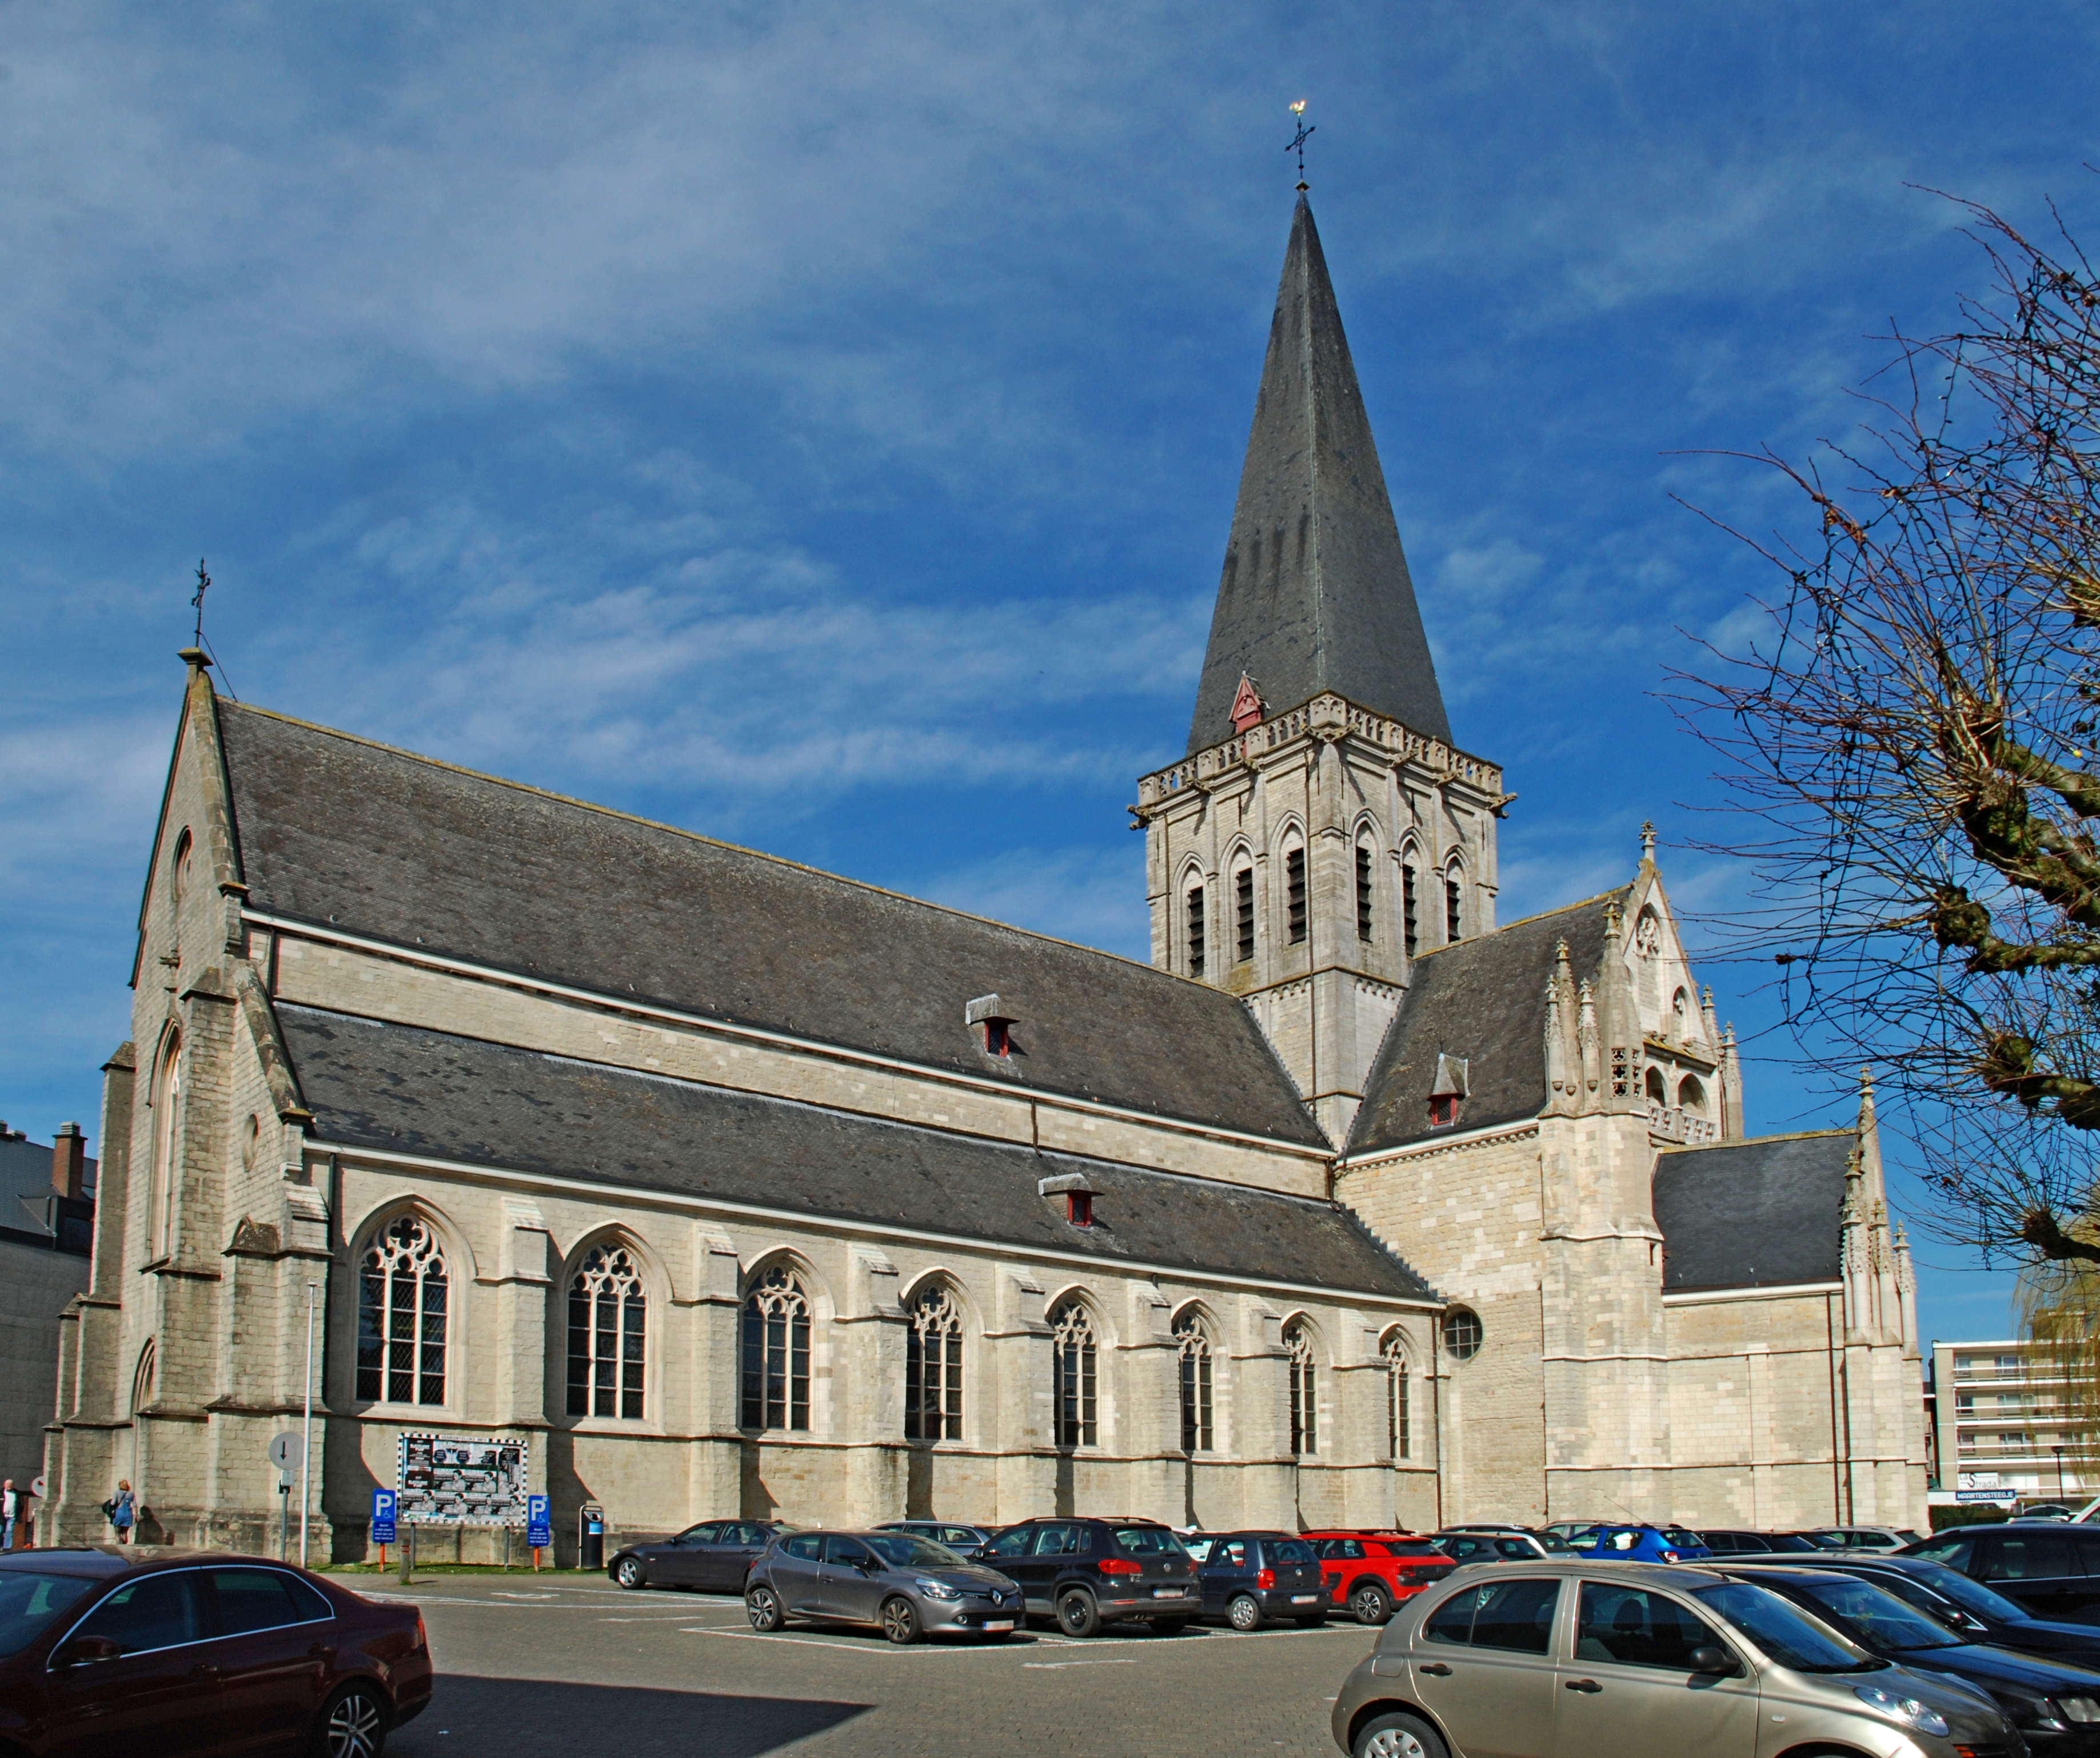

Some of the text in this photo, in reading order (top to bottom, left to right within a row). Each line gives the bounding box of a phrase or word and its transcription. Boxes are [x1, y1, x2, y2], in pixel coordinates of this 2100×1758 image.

[1967, 1472, 1997, 1488] Strada
[376, 1494, 393, 1517] P
[531, 1499, 546, 1521] P
